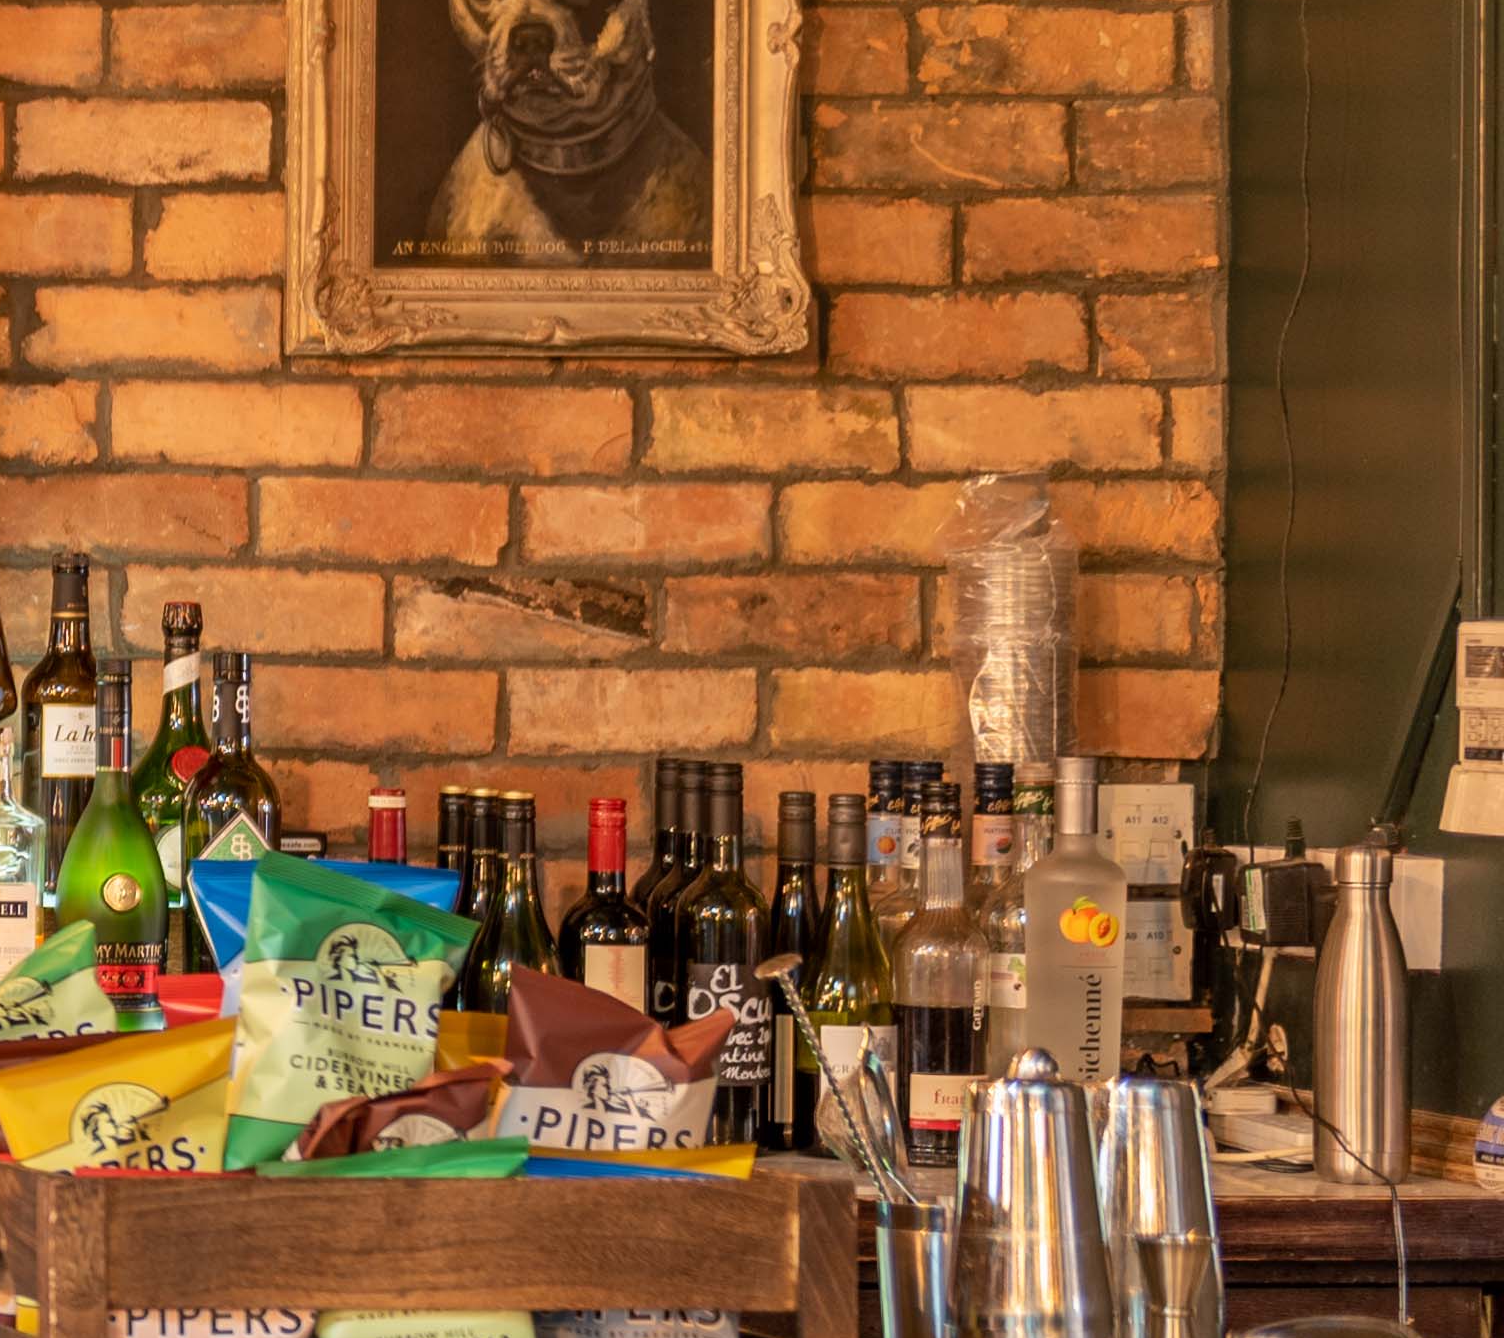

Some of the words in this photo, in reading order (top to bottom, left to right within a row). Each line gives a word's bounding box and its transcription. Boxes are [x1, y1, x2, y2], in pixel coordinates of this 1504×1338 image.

[392, 240, 414, 255] AN
[94, 944, 113, 958] MY
[292, 977, 442, 1039] PIPERS
[1079, 973, 1102, 1076] ichenné
[719, 1050, 766, 1063] ntina
[289, 1054, 354, 1077] CIDER
[355, 1067, 416, 1090] VINEG
[315, 1076, 328, 1090] &
[532, 1105, 694, 1150] PIPERS
[126, 1309, 302, 1338] PIPERS
